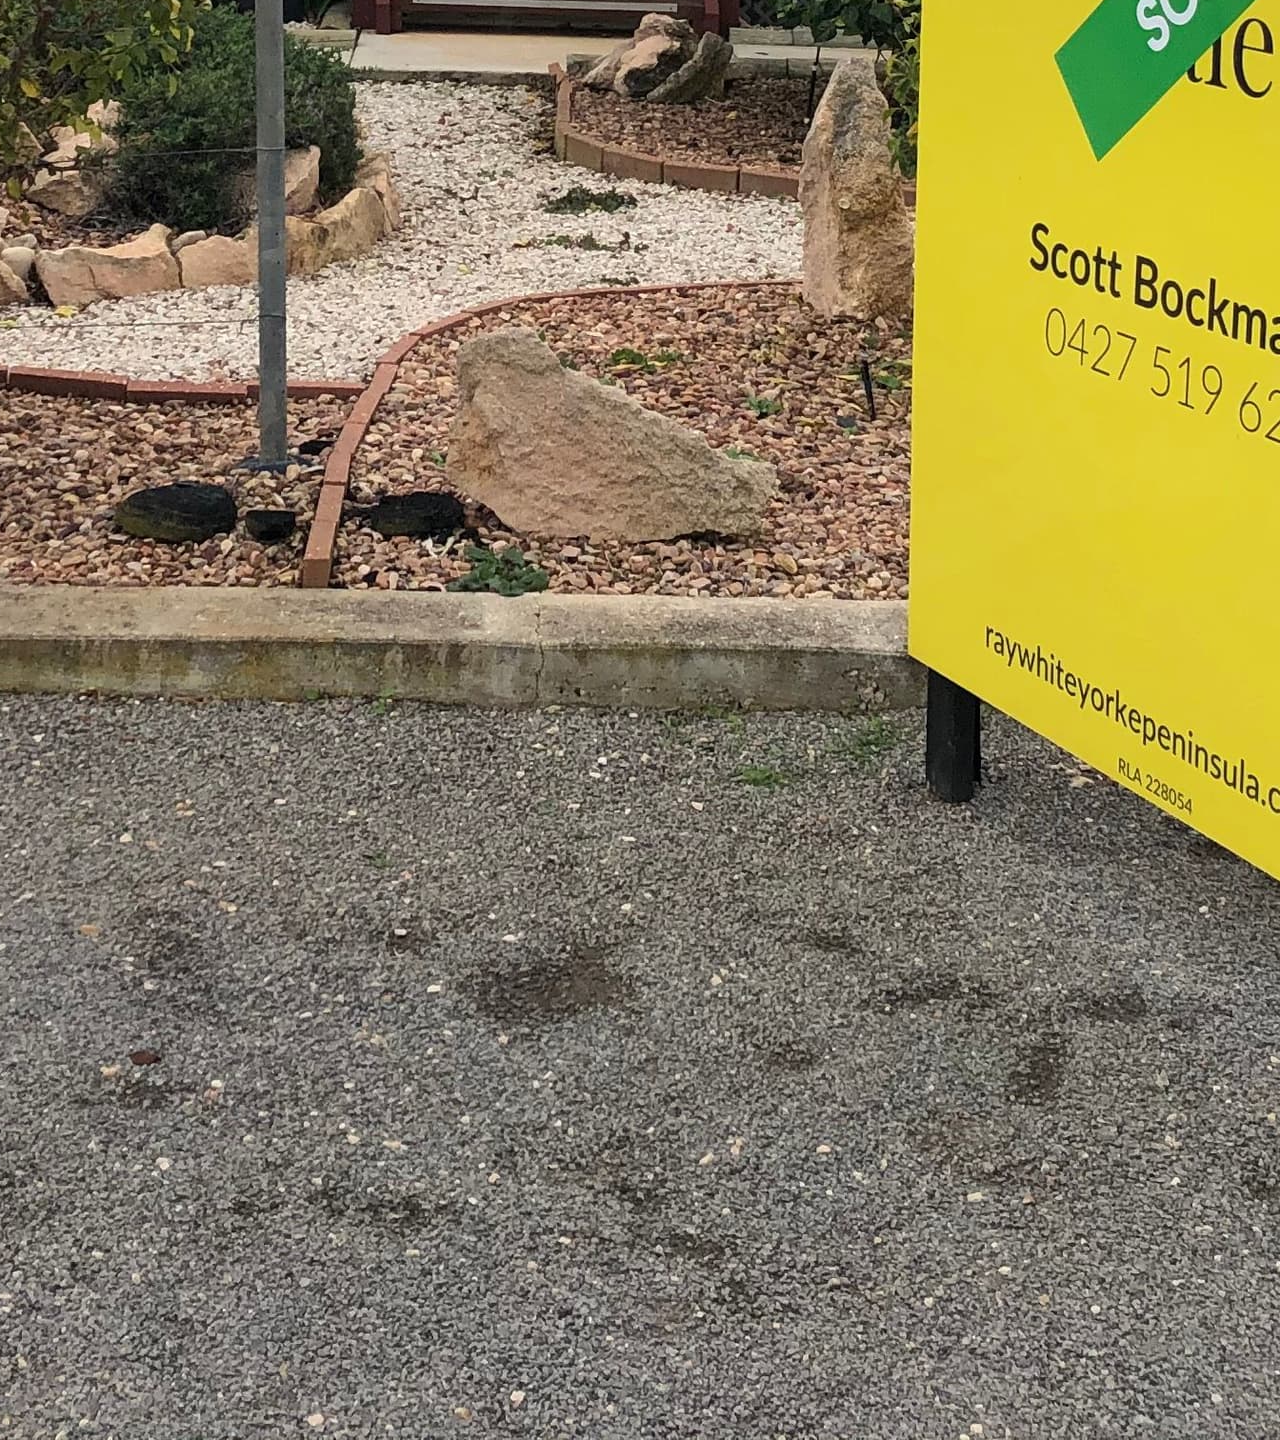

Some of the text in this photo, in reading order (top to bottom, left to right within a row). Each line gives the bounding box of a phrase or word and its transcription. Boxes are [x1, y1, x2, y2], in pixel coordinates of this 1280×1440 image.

[1029, 222, 1122, 298] Scott
[1045, 307, 1137, 381] 0427
[1150, 345, 1223, 415] 519
[1118, 757, 1193, 815] RLA 228054
